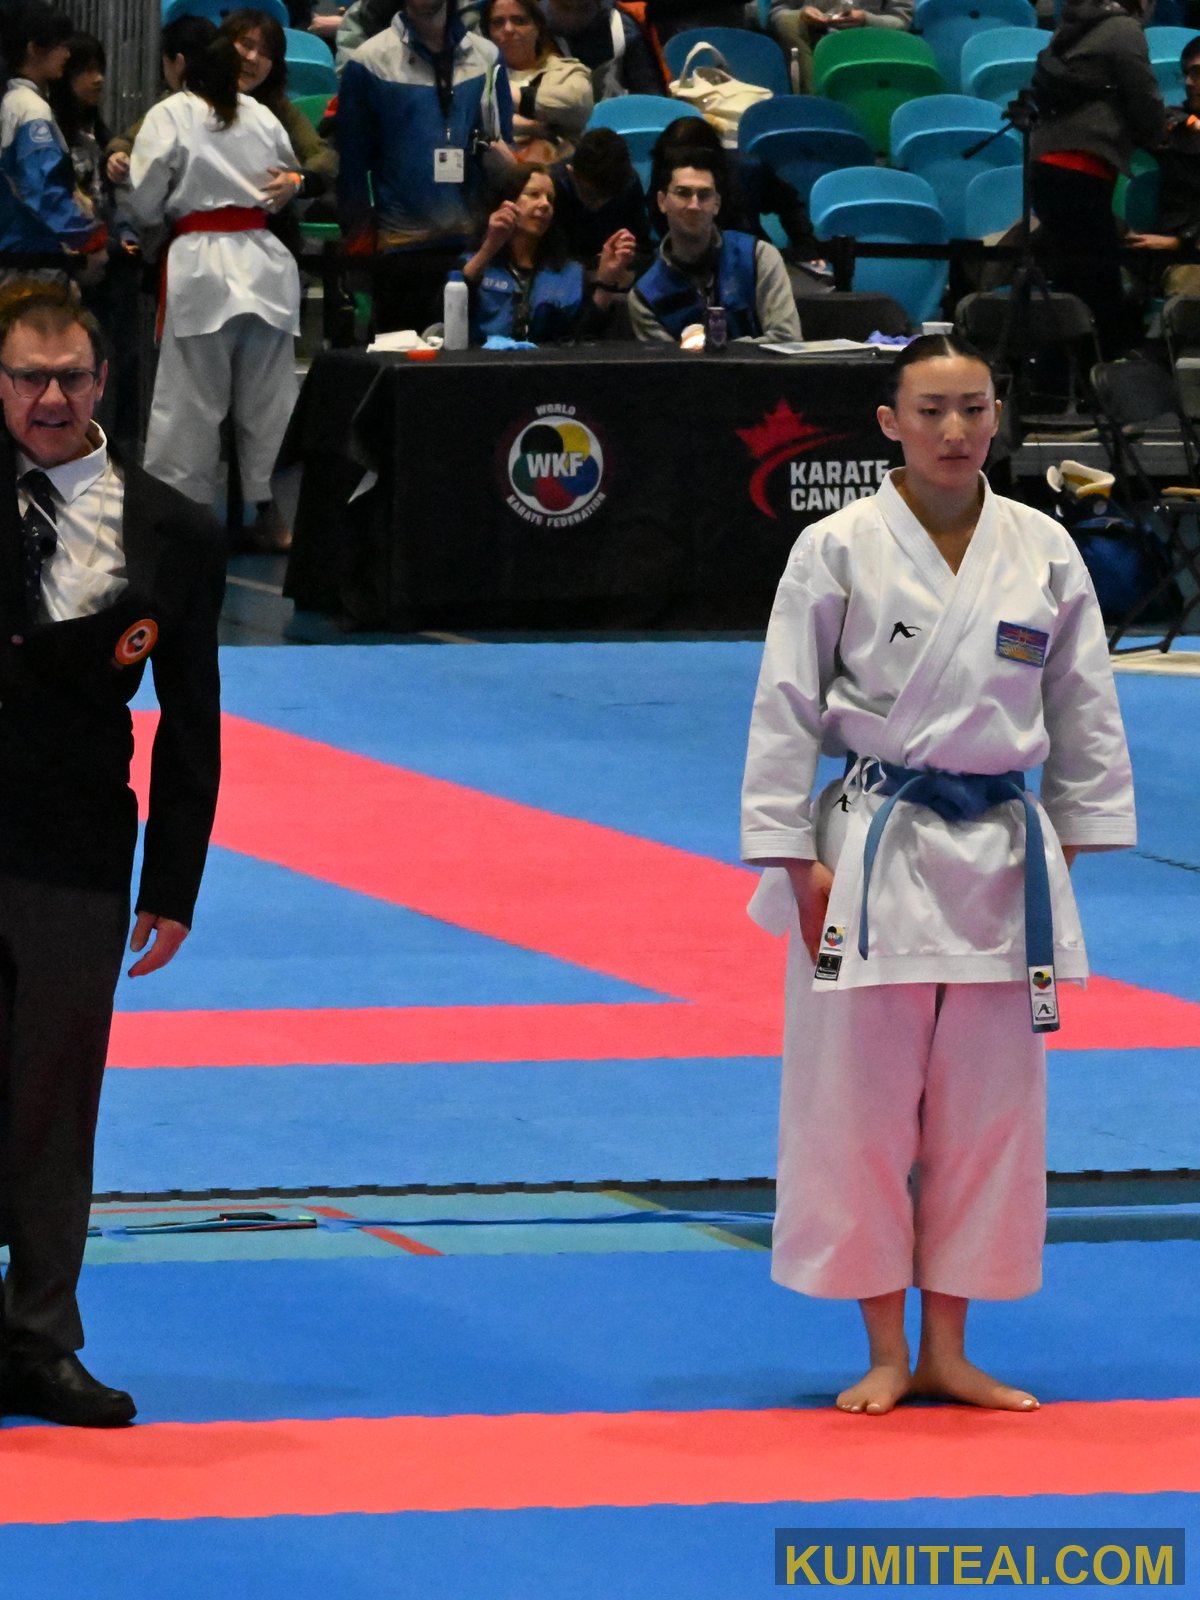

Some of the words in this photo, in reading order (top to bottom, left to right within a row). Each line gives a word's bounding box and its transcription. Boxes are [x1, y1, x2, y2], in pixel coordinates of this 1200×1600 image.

[535, 403, 576, 416] WORLD
[526, 452, 584, 478] WKF
[790, 460, 890, 485] KARATE
[505, 493, 544, 526] KARATE
